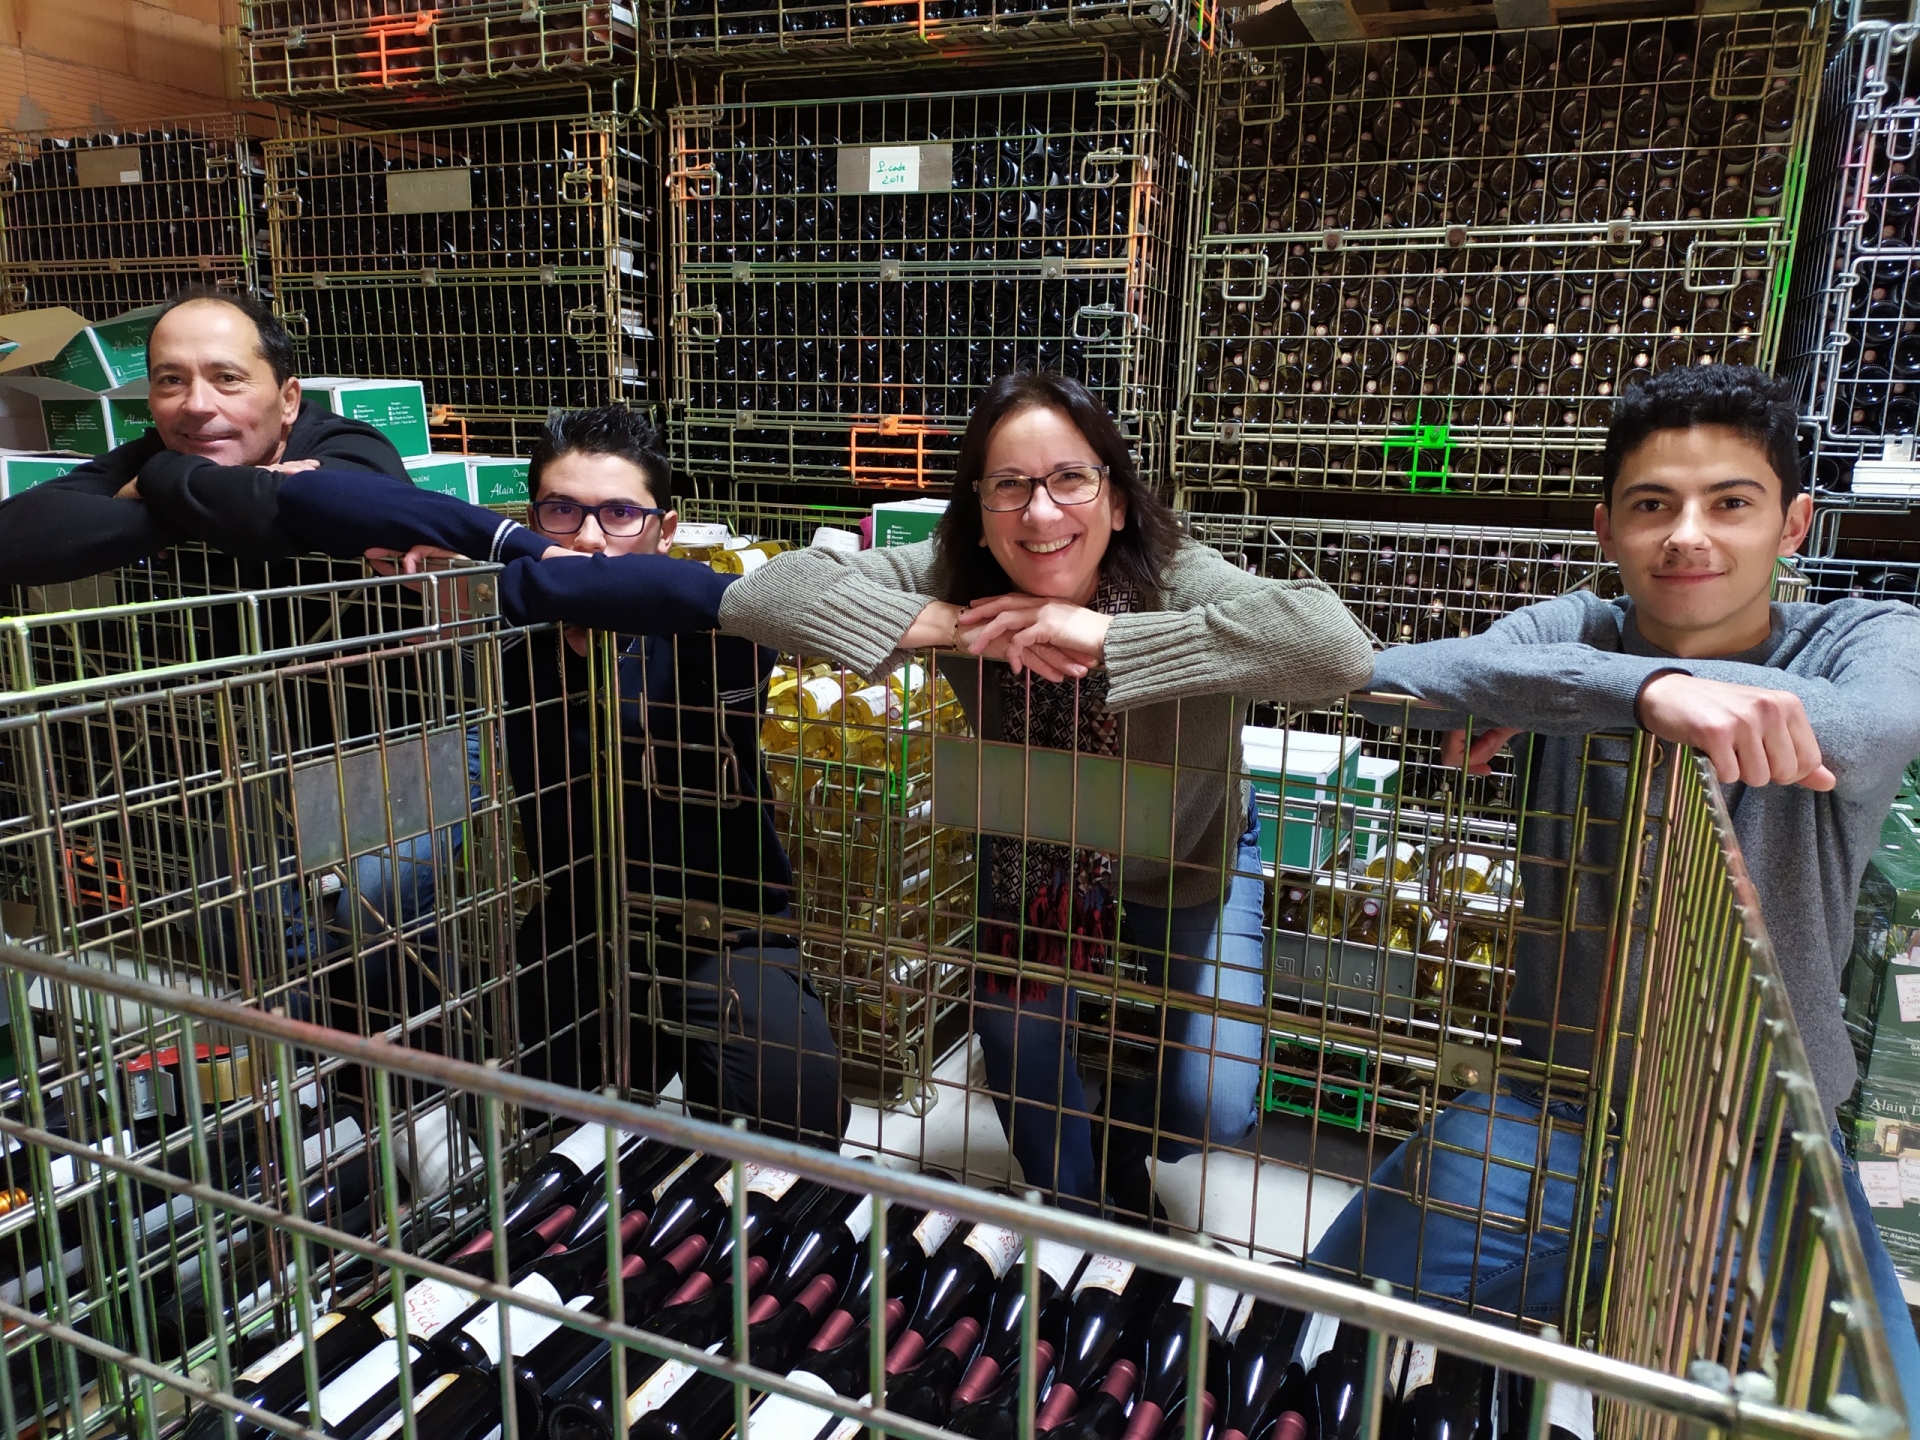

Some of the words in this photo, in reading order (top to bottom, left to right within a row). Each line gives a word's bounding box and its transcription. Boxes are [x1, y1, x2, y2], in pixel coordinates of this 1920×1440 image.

[882, 174, 905, 185] 2018
[490, 482, 514, 498] Alain
[1869, 1098, 1907, 1114] Alain
[408, 1298, 440, 1333] Sud
